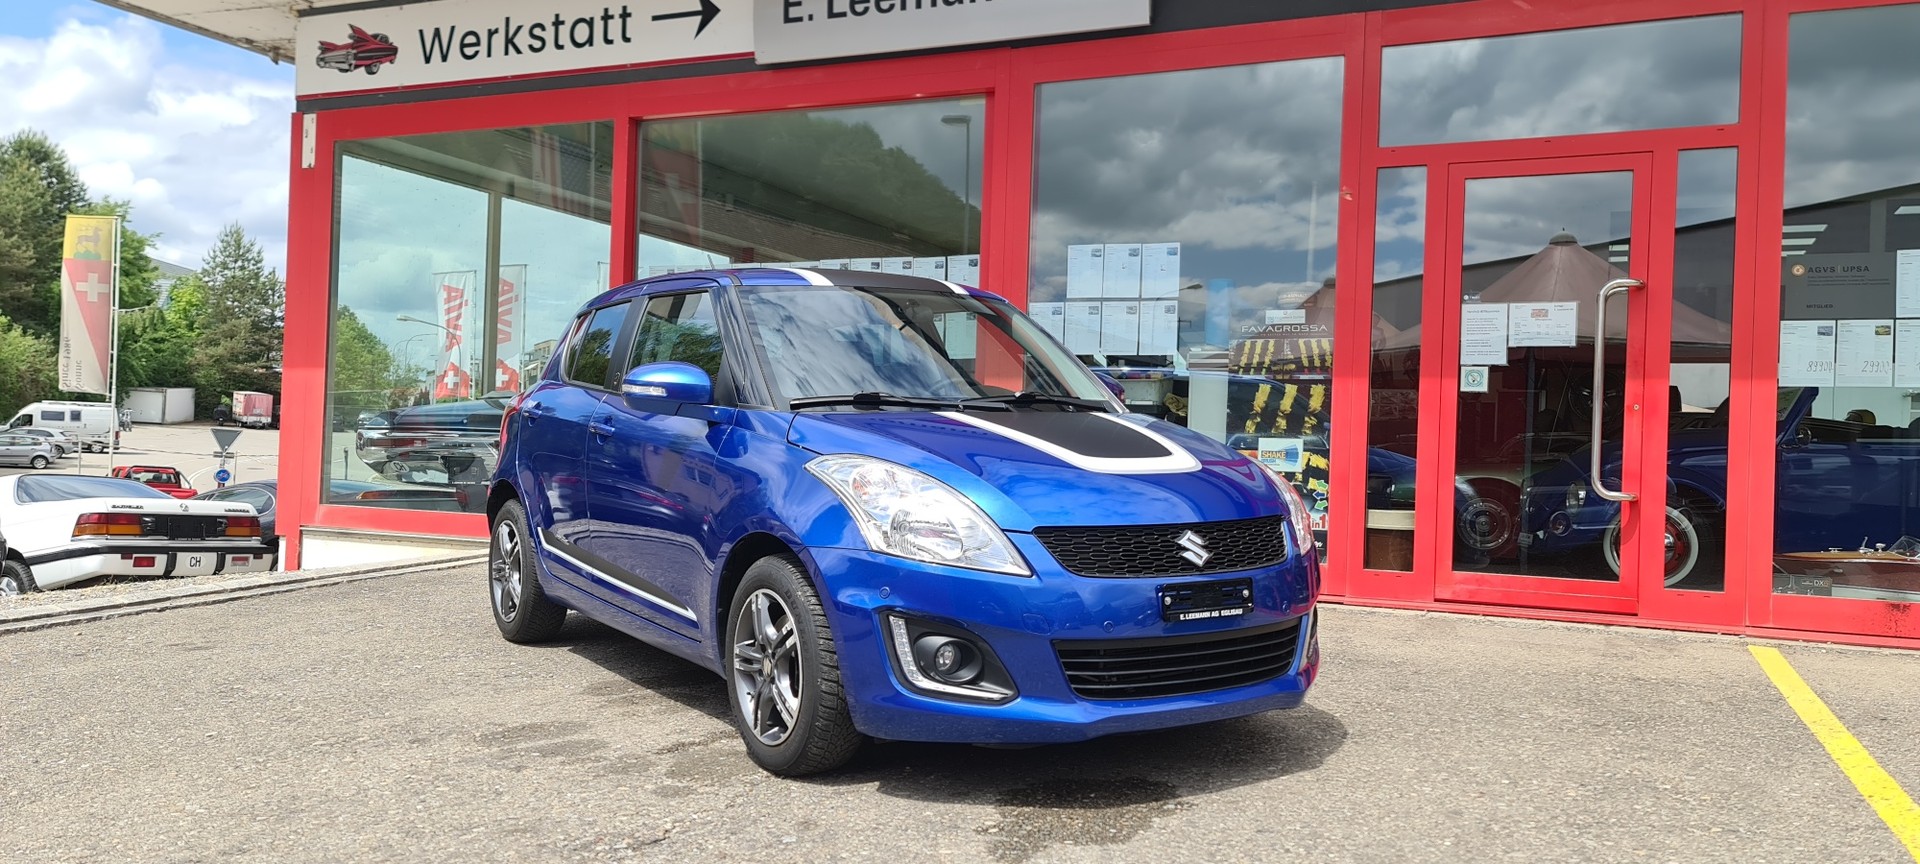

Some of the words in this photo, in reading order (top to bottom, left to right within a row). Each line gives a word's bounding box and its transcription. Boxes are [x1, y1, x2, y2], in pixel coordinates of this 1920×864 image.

[827, 0, 992, 19] Lee
[418, 4, 633, 65] Werkstatt
[1807, 266, 1836, 274] AGVS
[1842, 265, 1870, 273] UPSA
[1241, 324, 1329, 333] FAVAGROSSA
[1261, 451, 1286, 459] SHAKE
[189, 556, 202, 568] CH
[1211, 610, 1219, 618] AG
